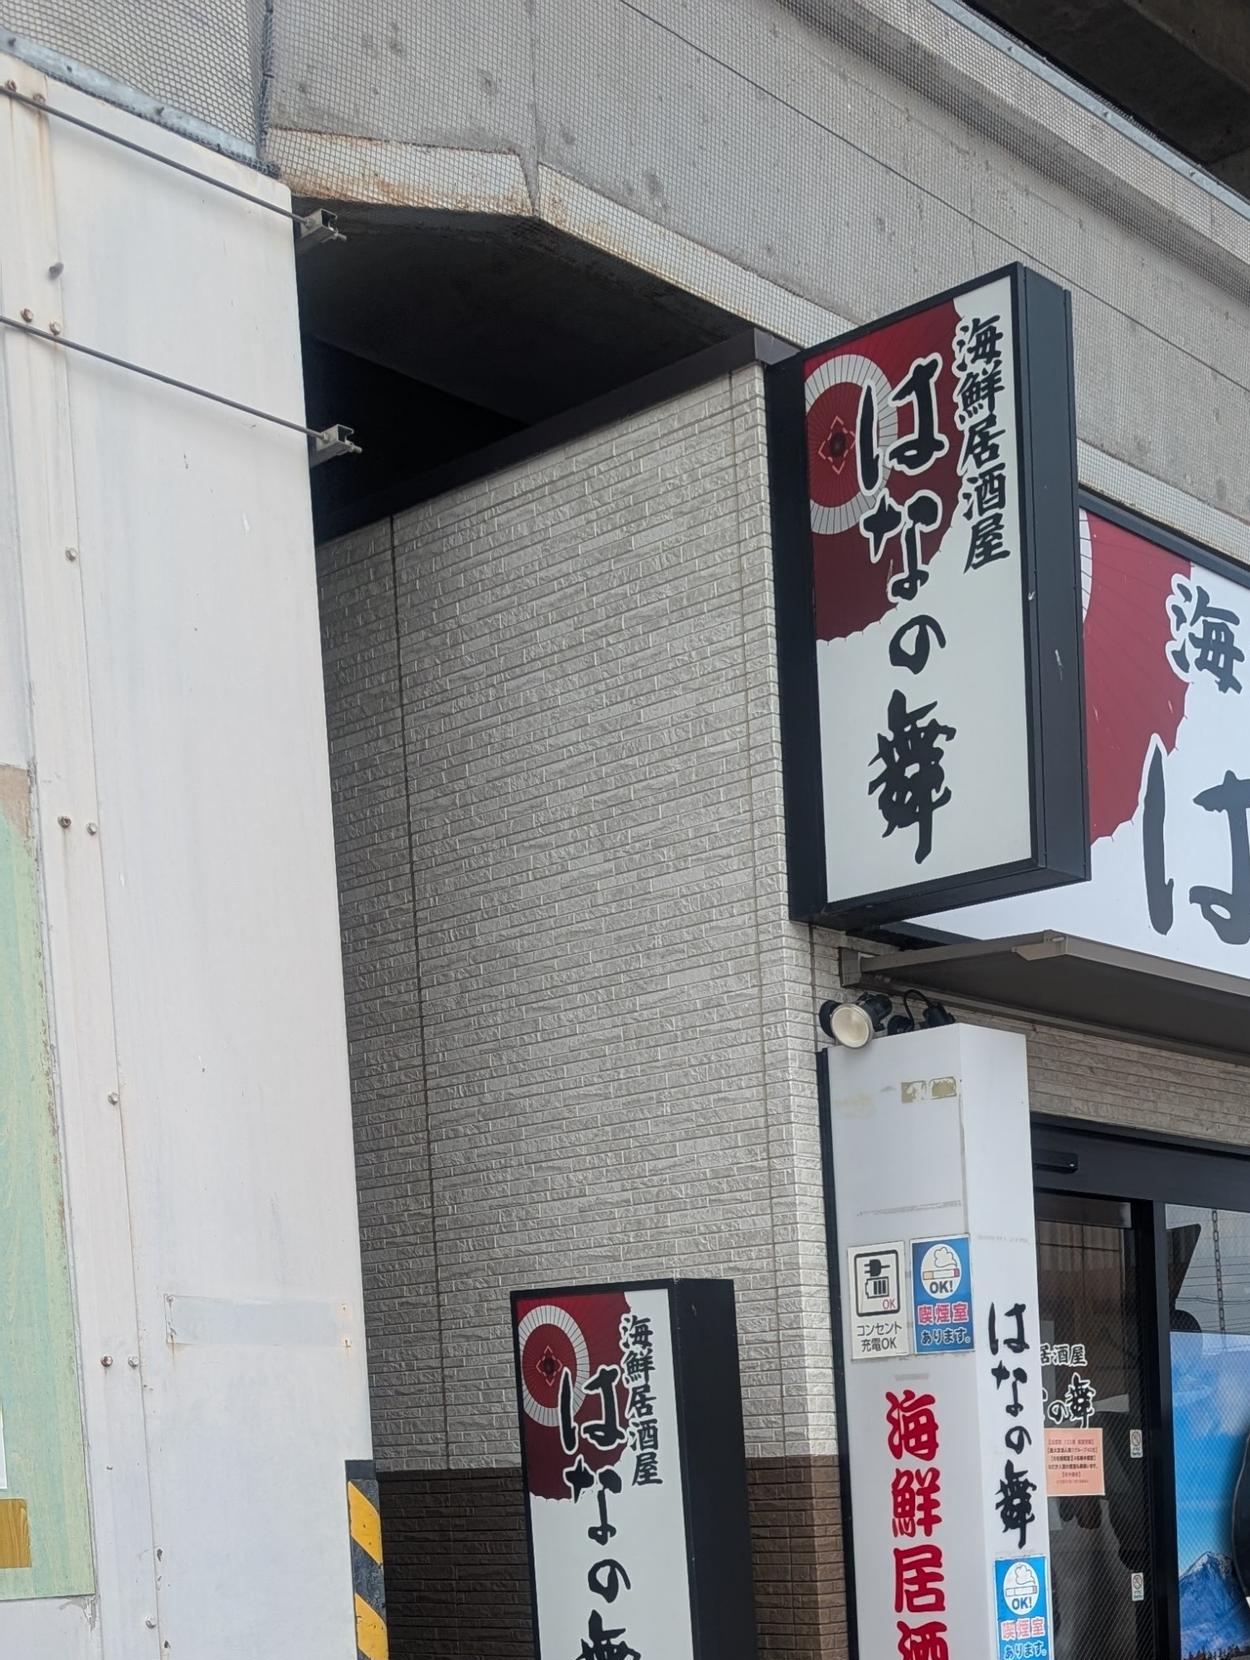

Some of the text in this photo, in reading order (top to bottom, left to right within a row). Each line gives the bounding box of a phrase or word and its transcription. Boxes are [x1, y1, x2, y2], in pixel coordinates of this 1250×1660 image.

[957, 315, 1011, 575] 海鮮居酒屋
[861, 357, 957, 864] はなの舞
[930, 1280, 954, 1295] OK!
[882, 1298, 896, 1310] OK
[918, 1301, 969, 1325] 喫煙室
[857, 1321, 902, 1337] コンセント
[921, 1327, 971, 1346] あります。
[861, 1336, 897, 1352] 充電OK
[621, 1315, 663, 1488] 海鮮居酒屋
[988, 1301, 1037, 1550] はなの舞
[1011, 1597, 1033, 1610] OK!
[1001, 1617, 1045, 1641] 喫煙室
[1003, 1640, 1048, 1660] あります。
